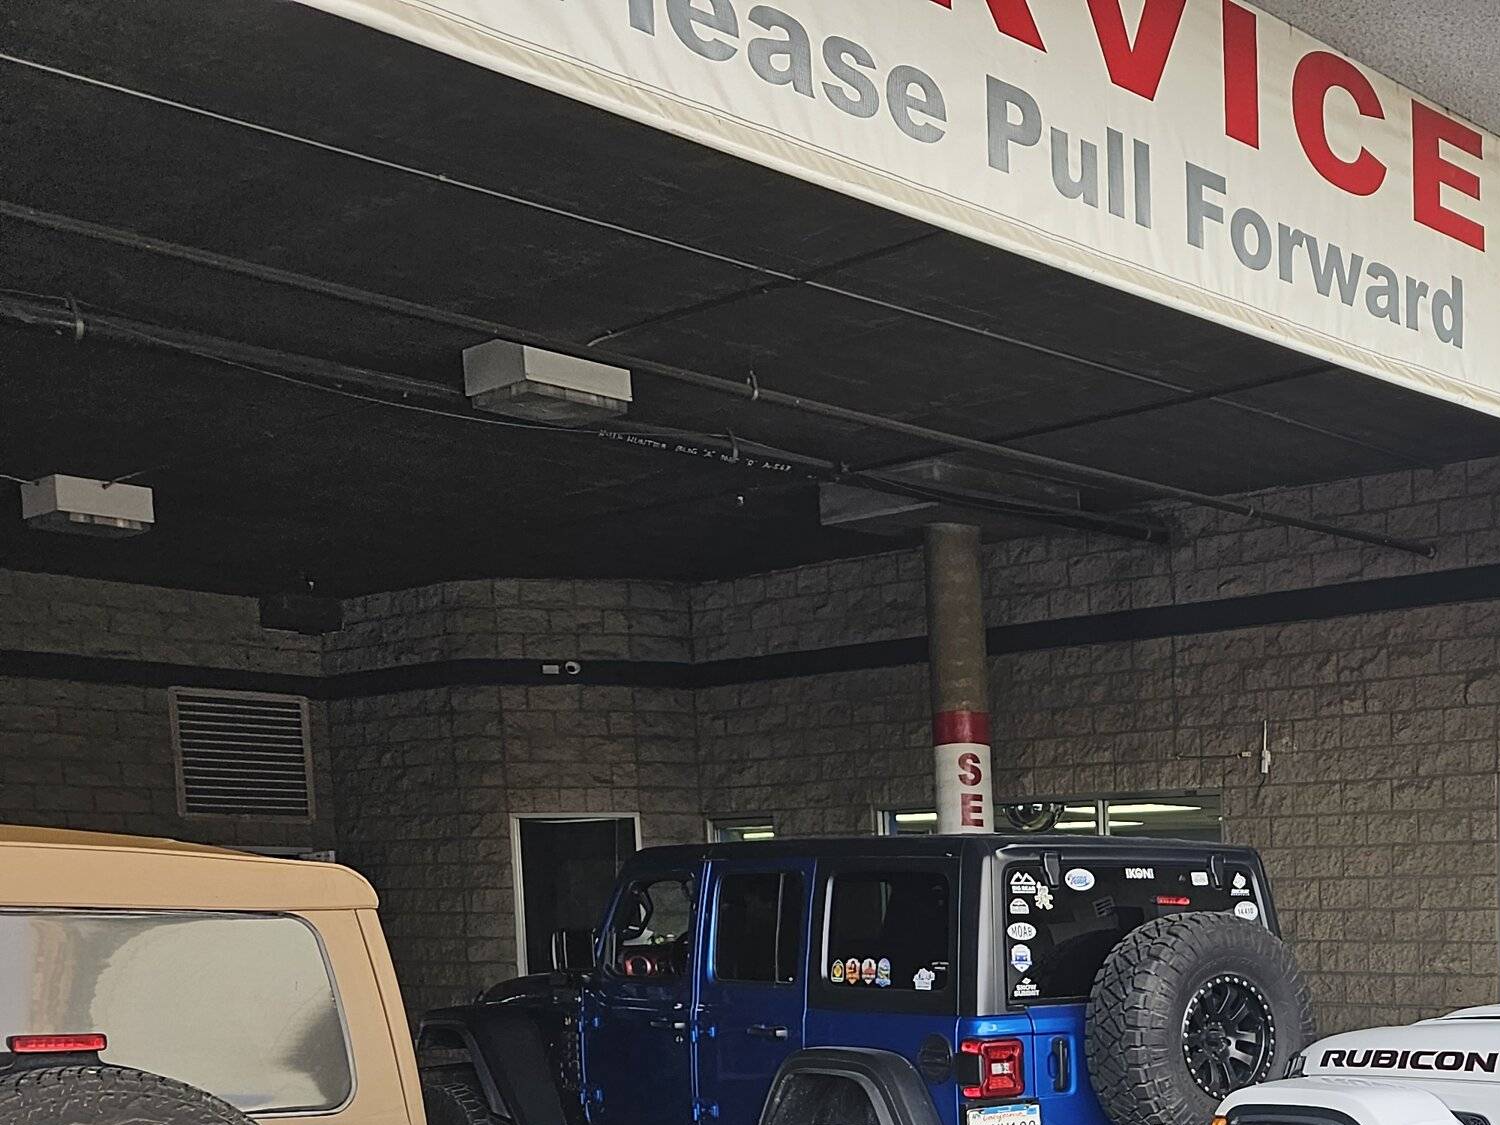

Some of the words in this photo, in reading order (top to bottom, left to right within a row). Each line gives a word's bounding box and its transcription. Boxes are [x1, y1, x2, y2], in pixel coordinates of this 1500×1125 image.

[941, 0, 1485, 252] VICE
[986, 74, 1152, 229] Pull
[1185, 161, 1463, 349] Forward
[958, 752, 984, 828] SE
[1011, 924, 1033, 938] MOAB
[1320, 1049, 1499, 1073] RUBICON
